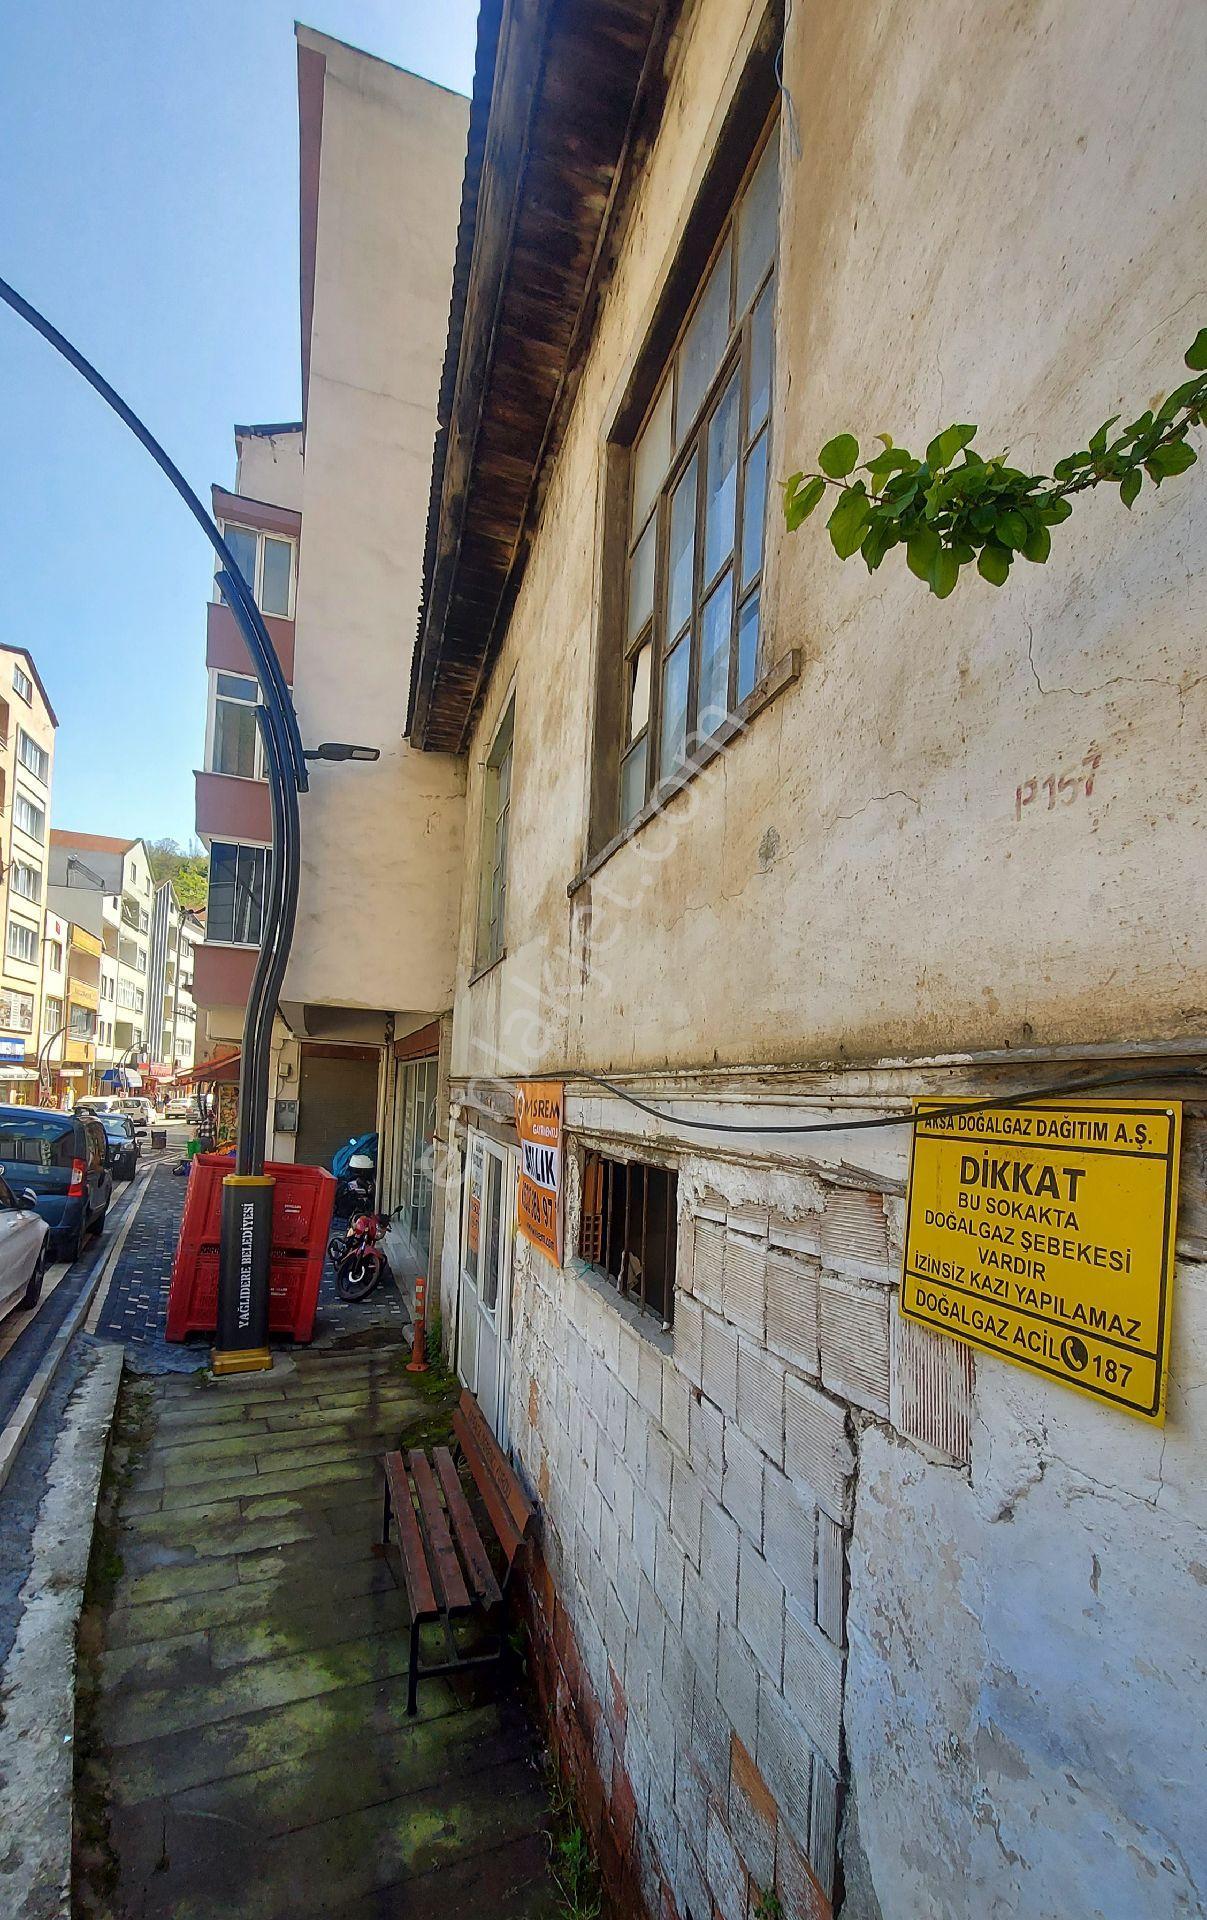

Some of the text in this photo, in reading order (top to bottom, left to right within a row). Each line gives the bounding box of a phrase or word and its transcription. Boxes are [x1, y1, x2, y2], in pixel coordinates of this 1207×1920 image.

[924, 1112, 1153, 1150] AKSA DOĞALGAZ DAĞITIM A.Ş.
[960, 1150, 1086, 1202] DİKKAT
[958, 1191, 1080, 1232] BU SOKAKTA
[237, 1202, 255, 1329] YAĞLIDERE BELEDİYESİ
[925, 1210, 1132, 1274] DOĞALGAZ ŞEBEKESİ
[978, 1246, 1046, 1282] VARDIR
[914, 1250, 1142, 1343] İZİNSİZ KAZI YAPILAMAZ
[916, 1289, 1134, 1389] DOĞALGAZ ACİL 187
